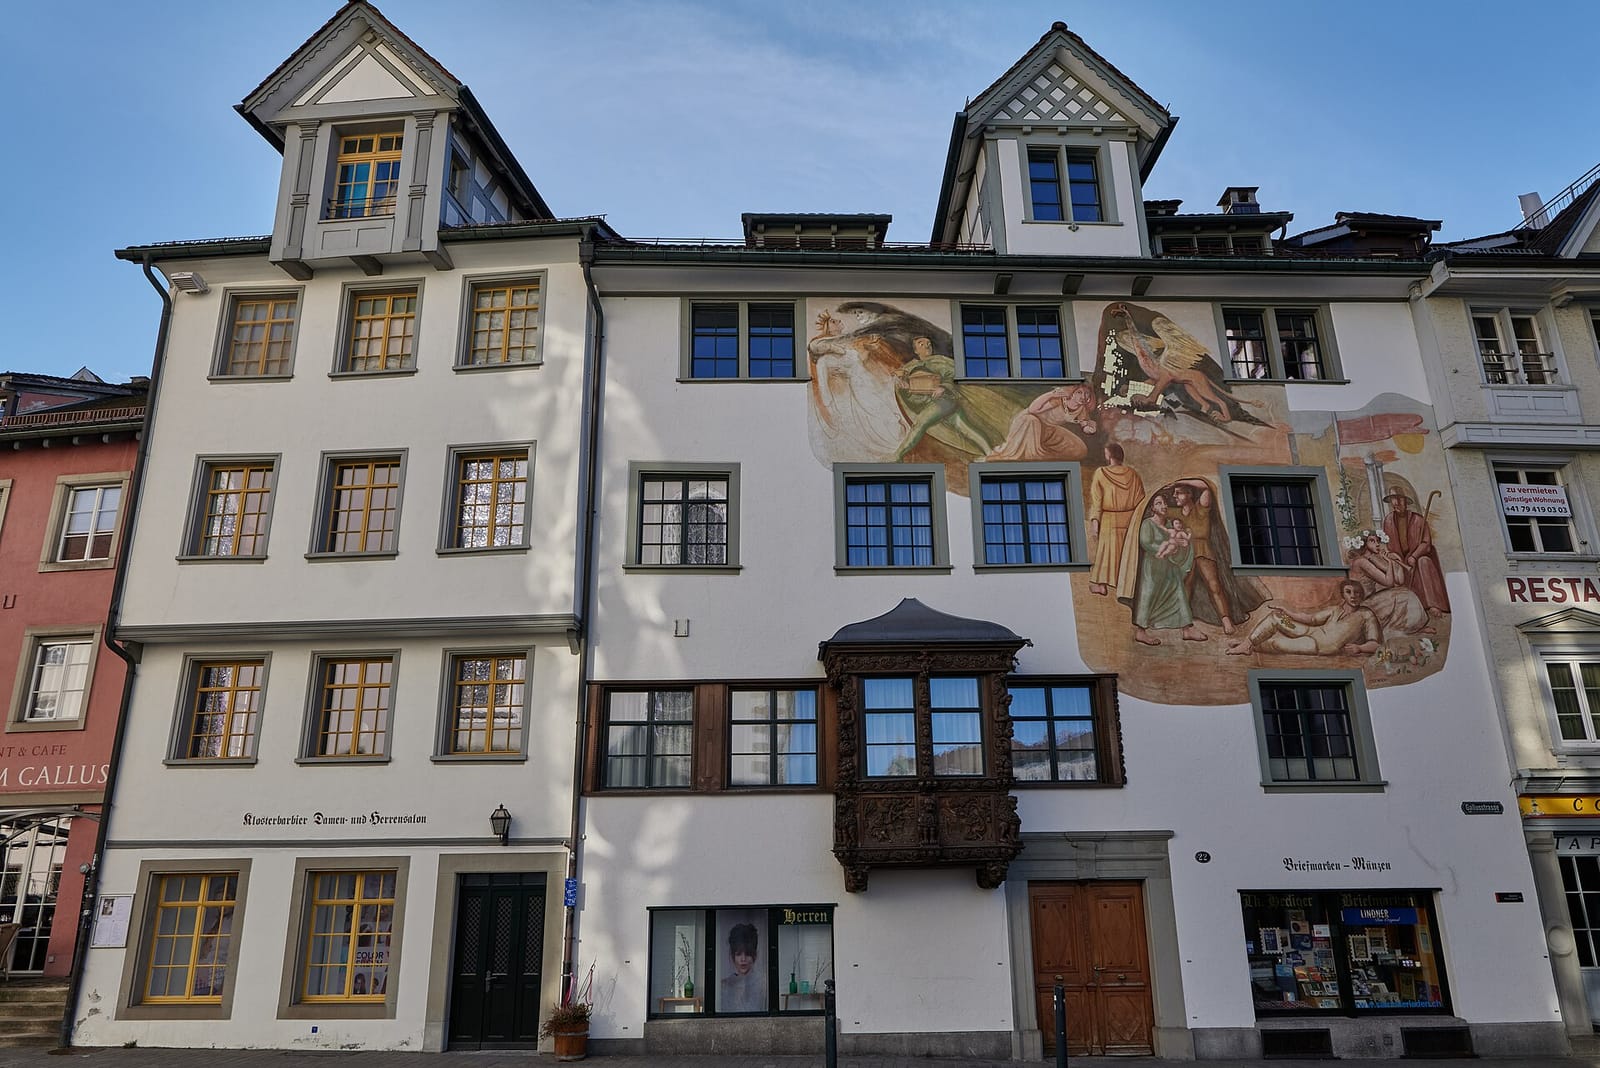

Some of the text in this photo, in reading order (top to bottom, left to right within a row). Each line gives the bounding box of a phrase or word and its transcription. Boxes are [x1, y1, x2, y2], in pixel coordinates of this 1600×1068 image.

[1532, 496, 1566, 504] Wohnung
[1506, 577, 1600, 603] RESTA
[18, 747, 27, 757] &
[32, 744, 67, 756] CAFE
[18, 764, 110, 786] GALLUS
[242, 811, 427, 825] Klosterbarbier Damen- und Herrensalon
[1283, 857, 1341, 872] Briefmarken
[1351, 857, 1392, 872] Münzen
[783, 908, 828, 925] Herren
[1360, 909, 1389, 919] LINDNER
[356, 951, 384, 959] COLOR
